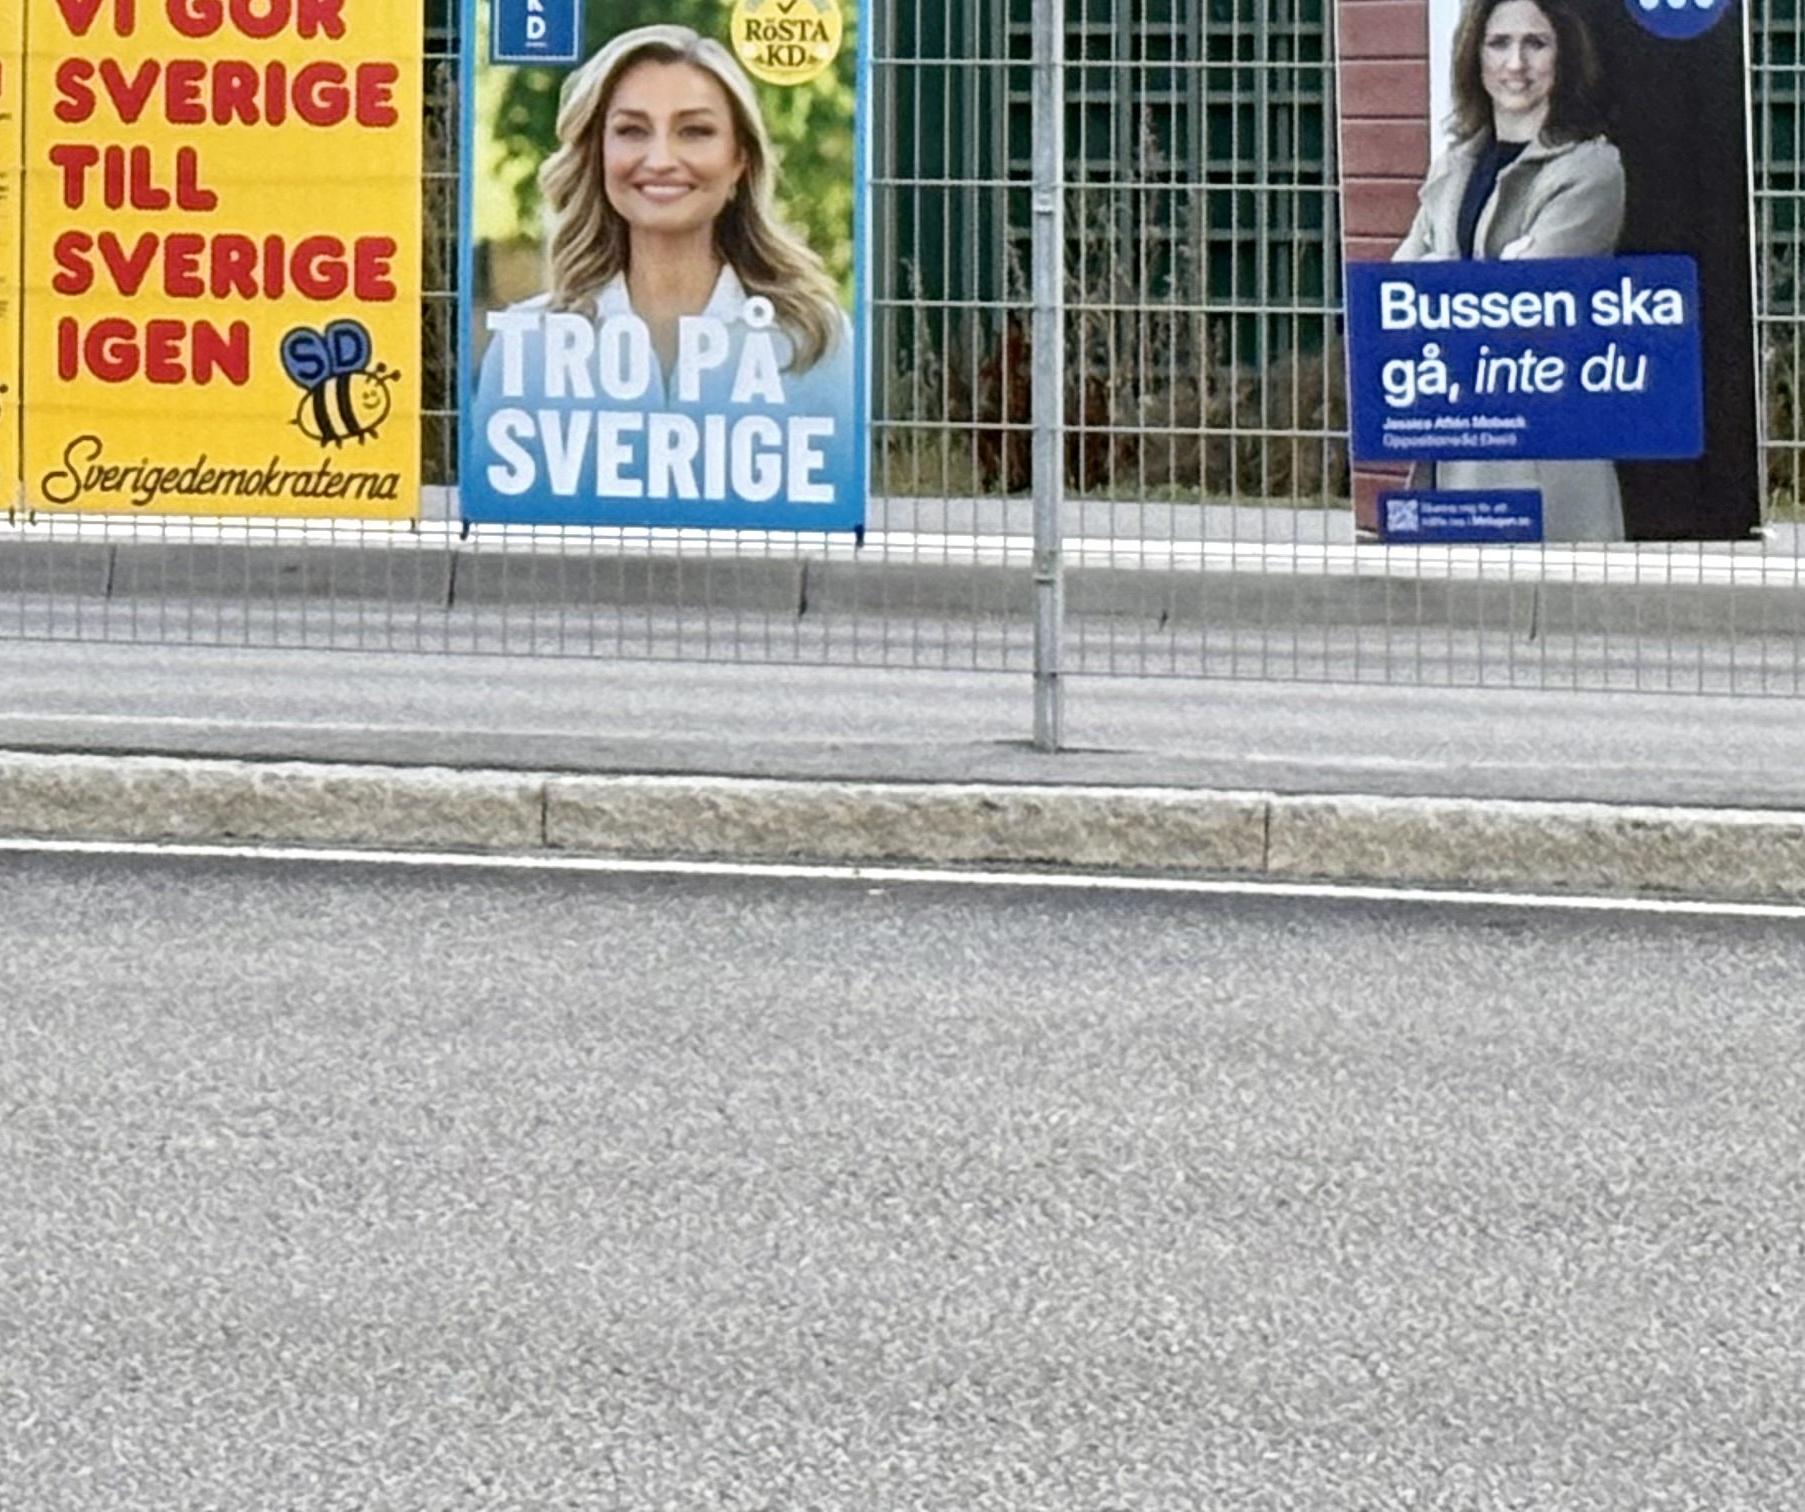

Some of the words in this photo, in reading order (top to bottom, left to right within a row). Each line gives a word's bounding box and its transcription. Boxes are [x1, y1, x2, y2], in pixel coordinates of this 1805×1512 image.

[766, 44, 806, 67] KD
[53, 57, 400, 128] SVERIGE
[49, 144, 219, 212] TILL
[52, 230, 398, 301] SVERIGE
[1380, 281, 1577, 330] Bussen
[1591, 276, 1684, 326] ska
[58, 316, 250, 386] IGEN
[289, 326, 363, 381] SD
[486, 310, 651, 400] TRO
[678, 295, 786, 405] PÅ
[1382, 342, 1460, 408] gå,
[1475, 345, 1565, 394] inte
[1580, 342, 1646, 392] du
[41, 435, 400, 506] Sverigedemokraterna
[487, 407, 836, 504] SVERIGE
